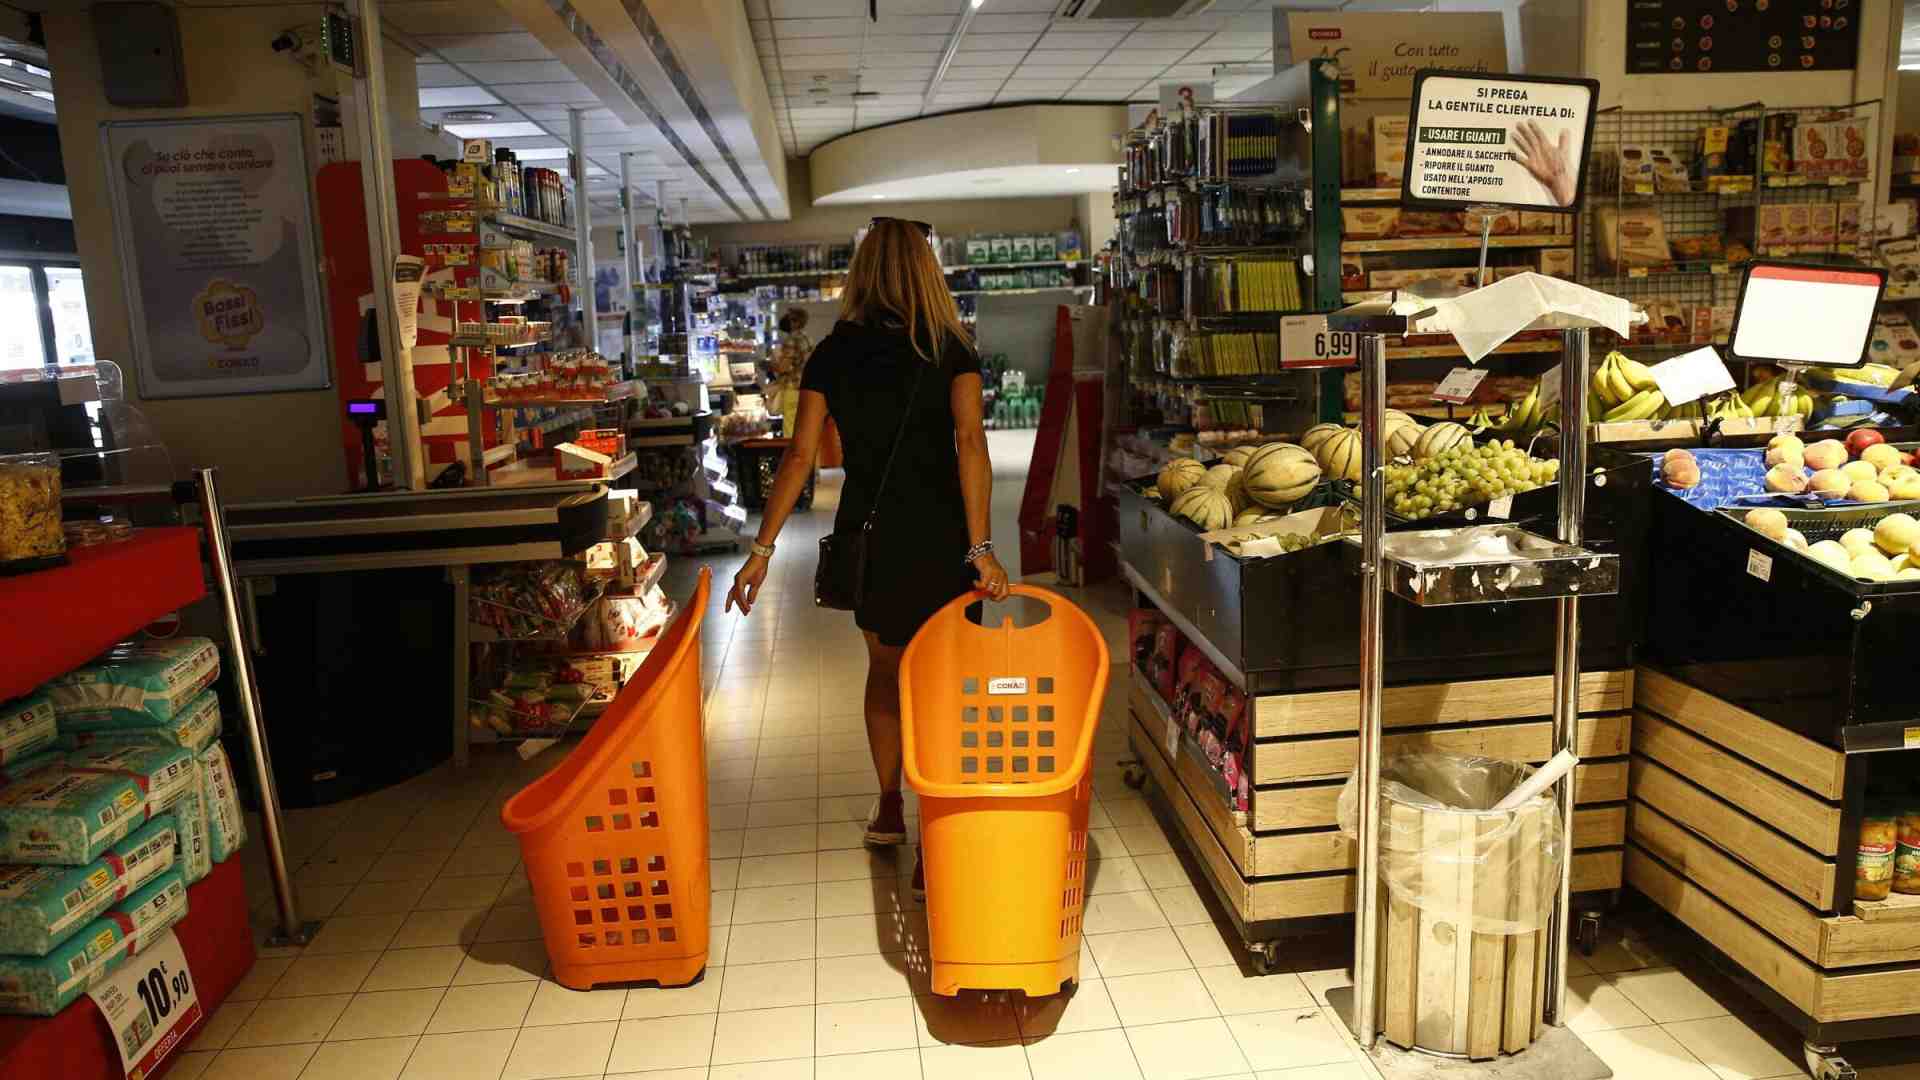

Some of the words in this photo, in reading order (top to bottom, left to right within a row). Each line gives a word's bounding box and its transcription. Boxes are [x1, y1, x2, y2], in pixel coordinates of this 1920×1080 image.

[1394, 42, 1424, 57] Con
[1428, 42, 1459, 57] tutto
[1368, 60, 1378, 77] il
[1382, 63, 1417, 80] gusto
[1477, 87, 1488, 98] SI
[1491, 88, 1528, 100] PREGA
[1428, 100, 1442, 110] LA
[1445, 101, 1493, 113] GENTILE
[1496, 104, 1557, 118] CLIENTELA
[1560, 108, 1575, 119] DI:
[1428, 129, 1459, 141] USARE
[1465, 131, 1500, 142] GUANTI
[1425, 148, 1465, 159] ANNODARE
[1466, 150, 1473, 159] IL
[1475, 150, 1517, 161] SACCHETTO
[1424, 161, 1456, 171] RIPORRE
[1457, 162, 1464, 171] IL
[1465, 163, 1494, 173] GUANTO
[1423, 174, 1447, 183] USATO
[1422, 186, 1471, 197] CONTENITORE
[1315, 332, 1351, 360] 6,99
[137, 968, 171, 1027] 10
